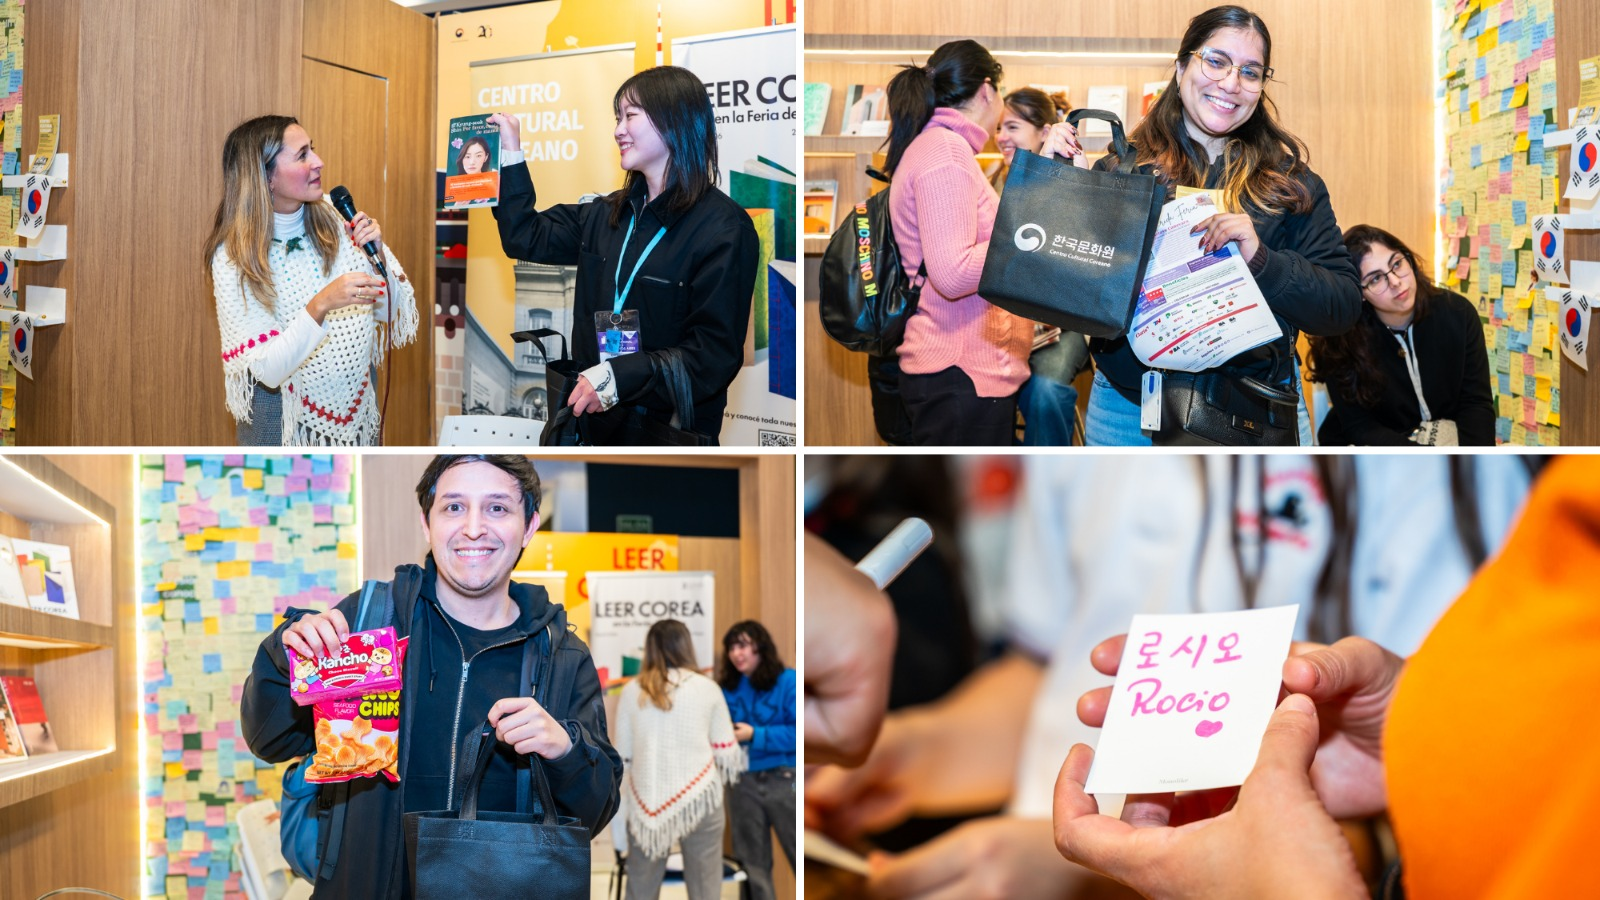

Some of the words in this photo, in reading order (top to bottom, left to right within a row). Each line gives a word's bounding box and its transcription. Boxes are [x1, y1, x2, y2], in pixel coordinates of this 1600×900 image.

[478, 82, 560, 108] CENTRO
[704, 80, 751, 108] EER
[513, 109, 584, 133] TURAL
[714, 116, 730, 124] en
[733, 110, 744, 123] la
[748, 109, 779, 122] Feria
[520, 139, 578, 162] EANO
[857, 217, 873, 280] MOSCHINO
[1052, 234, 1115, 259] 한국문화원
[1050, 249, 1067, 258] Centro
[1068, 253, 1088, 262] Cultural
[1089, 258, 1111, 268] Coreano
[612, 548, 666, 570] LEER
[595, 601, 635, 618] LEER
[639, 601, 704, 618] COREA
[318, 653, 368, 670] Kancho
[1136, 631, 1242, 669] 로시오
[359, 701, 400, 716] CHIPS
[1127, 678, 1230, 717] Rocio
